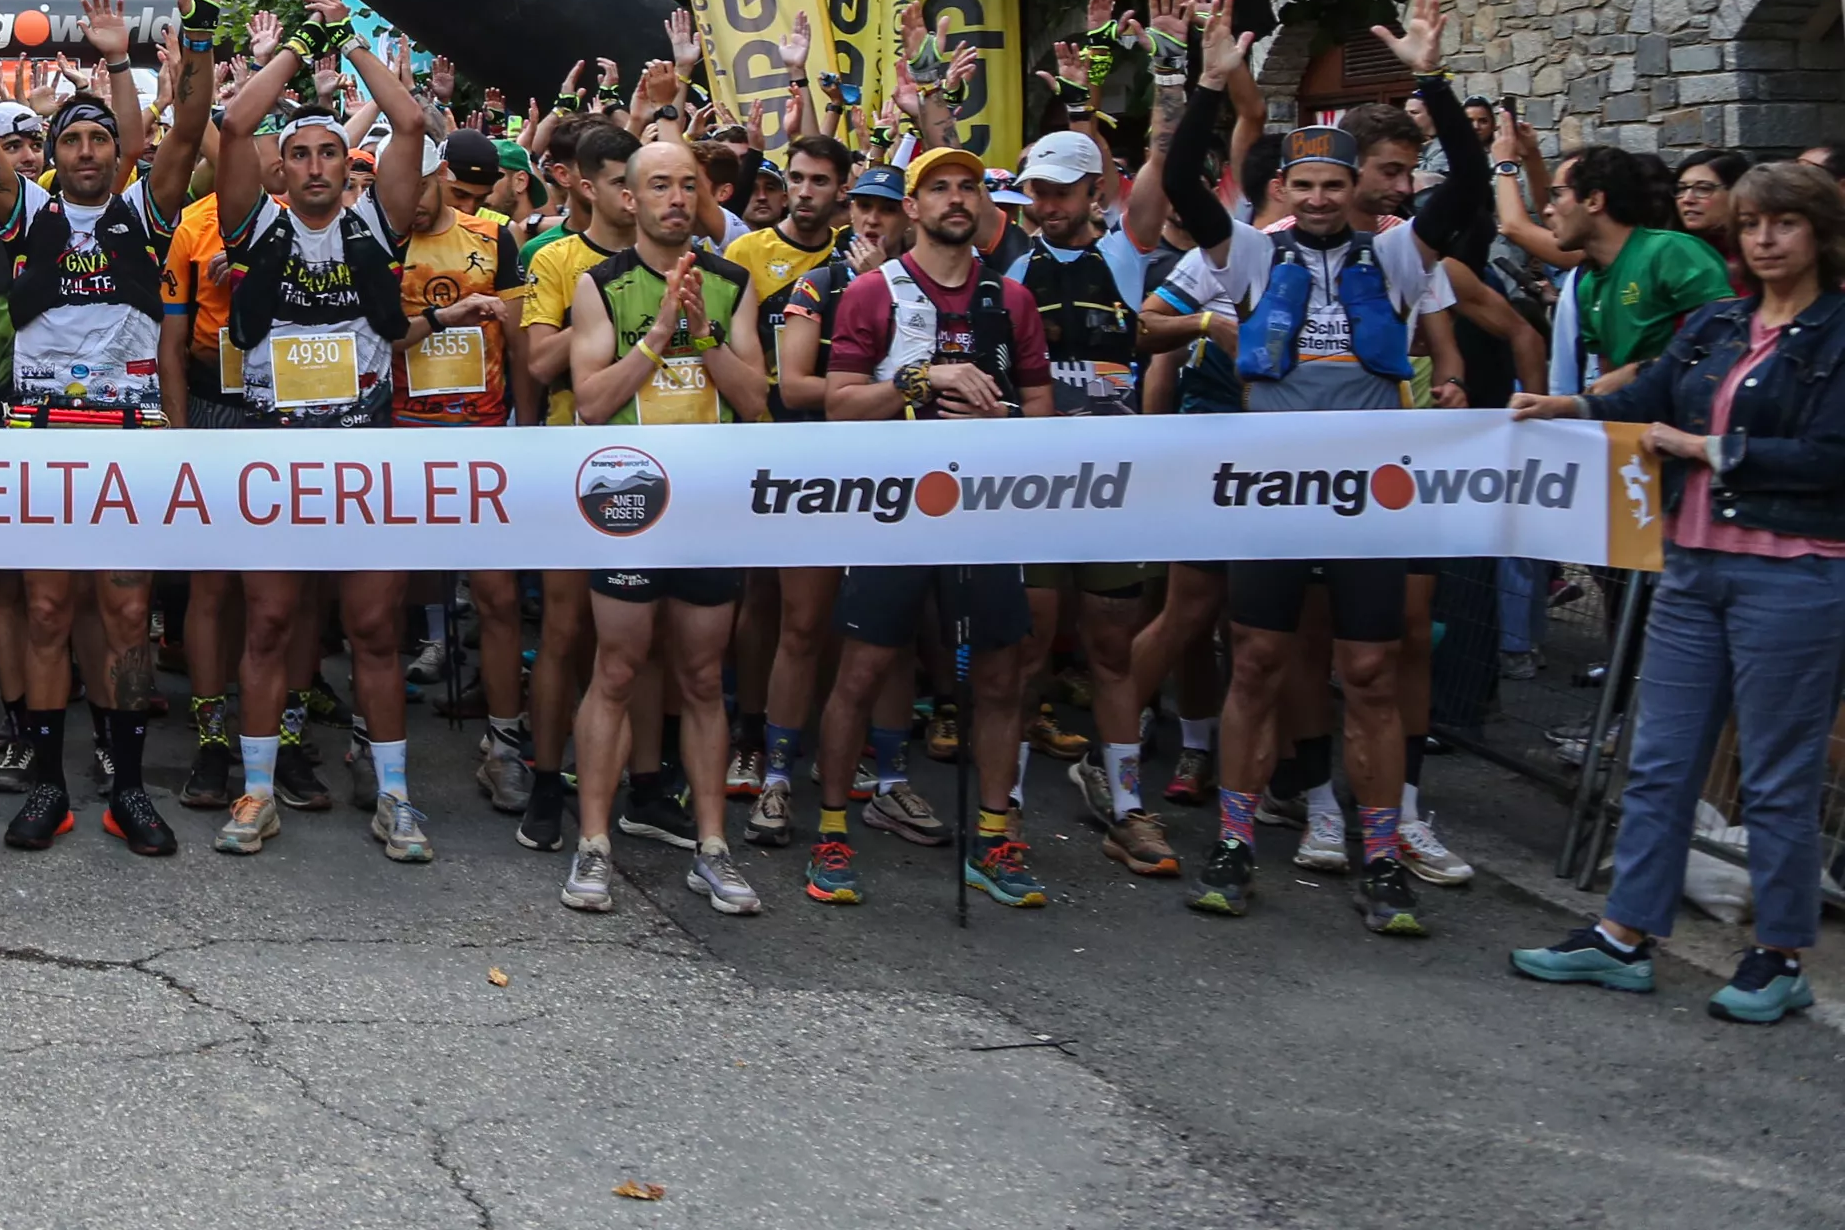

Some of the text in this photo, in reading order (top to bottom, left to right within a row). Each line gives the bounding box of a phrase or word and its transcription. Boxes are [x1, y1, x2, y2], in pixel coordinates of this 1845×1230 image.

[316, 290, 360, 306] TEAM
[287, 341, 340, 365] 4930
[420, 335, 470, 357] 4555
[163, 461, 212, 526] A
[238, 460, 511, 527] CERLER
[750, 461, 1133, 524] trangoworld
[1212, 458, 1579, 517] trangoworld
[613, 494, 646, 507] ANETO
[604, 507, 646, 520] POSETS
